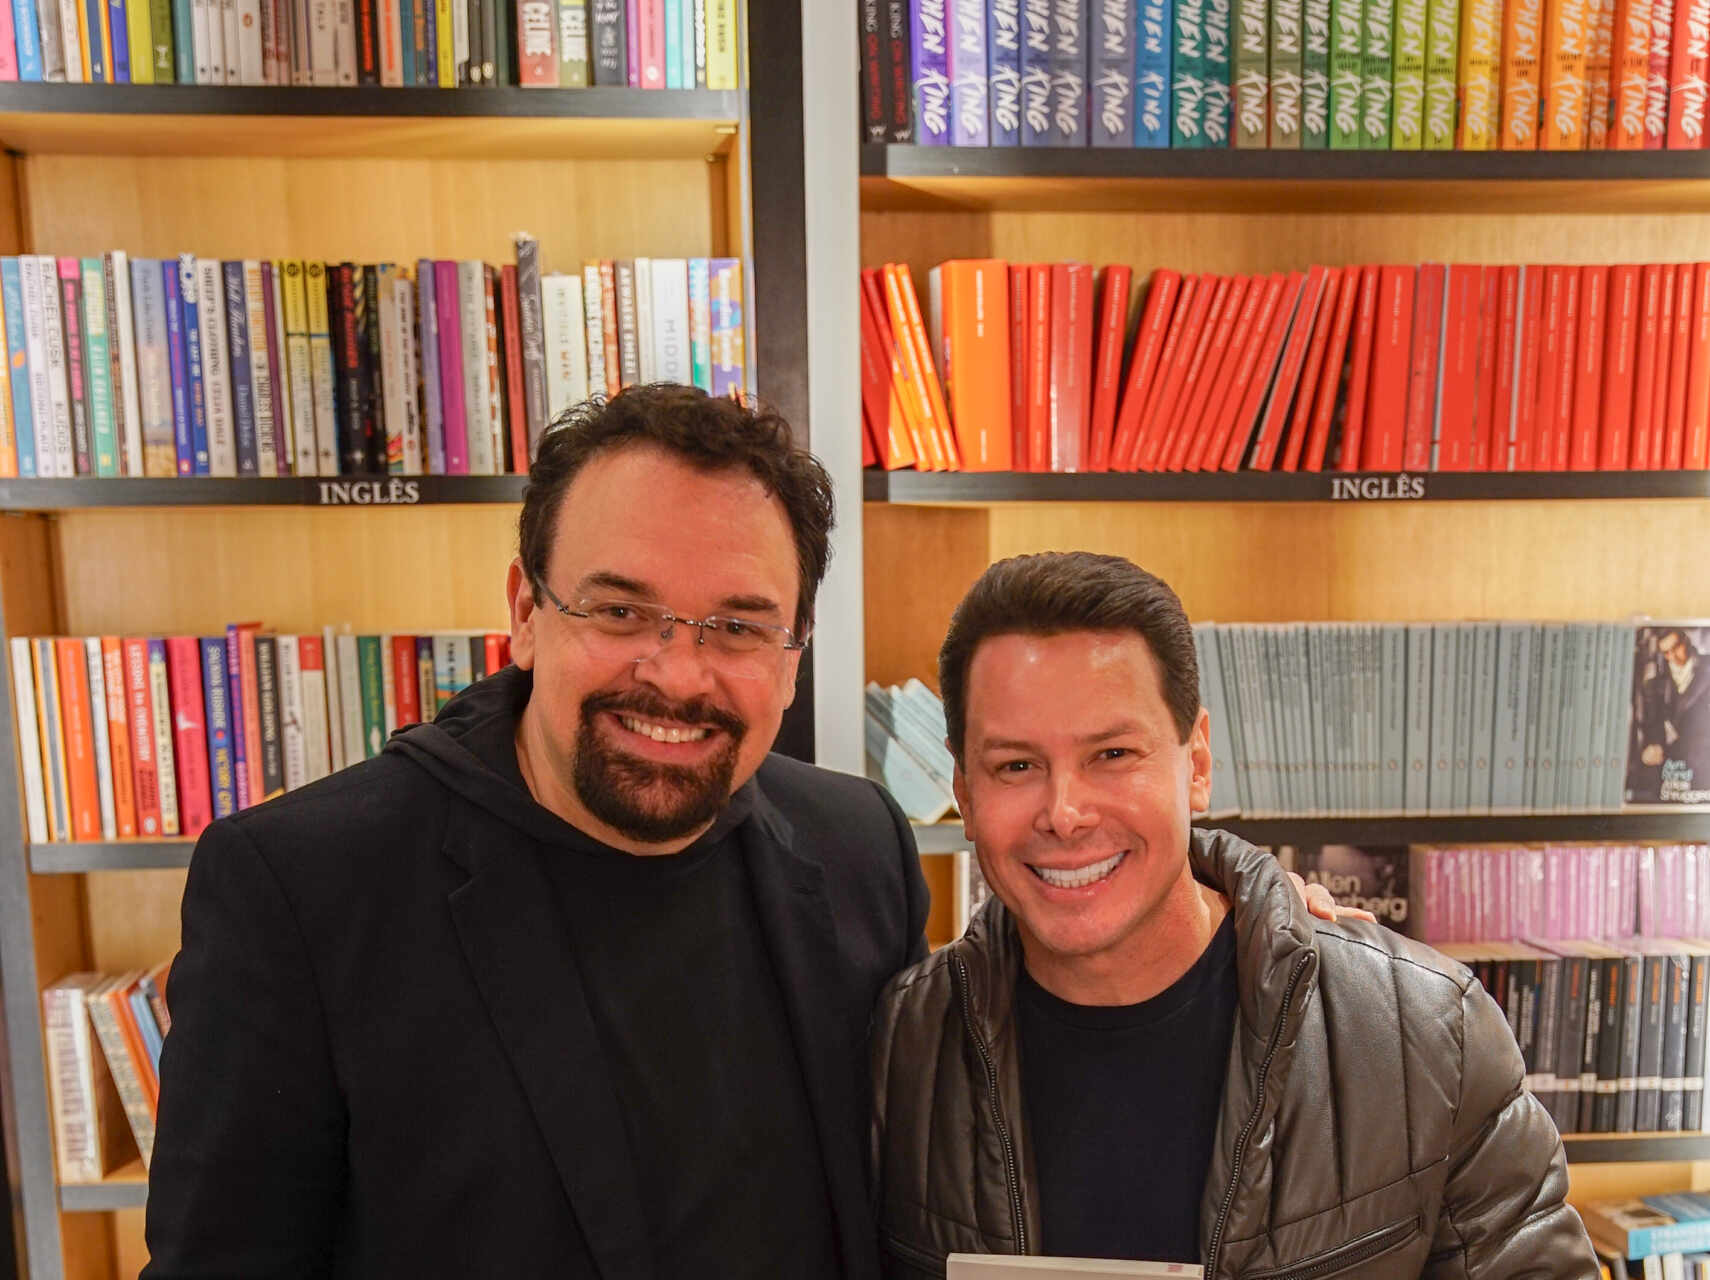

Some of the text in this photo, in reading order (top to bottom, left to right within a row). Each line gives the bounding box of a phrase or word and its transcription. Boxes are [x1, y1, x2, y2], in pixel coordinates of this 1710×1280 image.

[663, 320, 680, 385] MIDD
[319, 478, 420, 504] INGLÊS
[1330, 472, 1425, 500] INGLÊS
